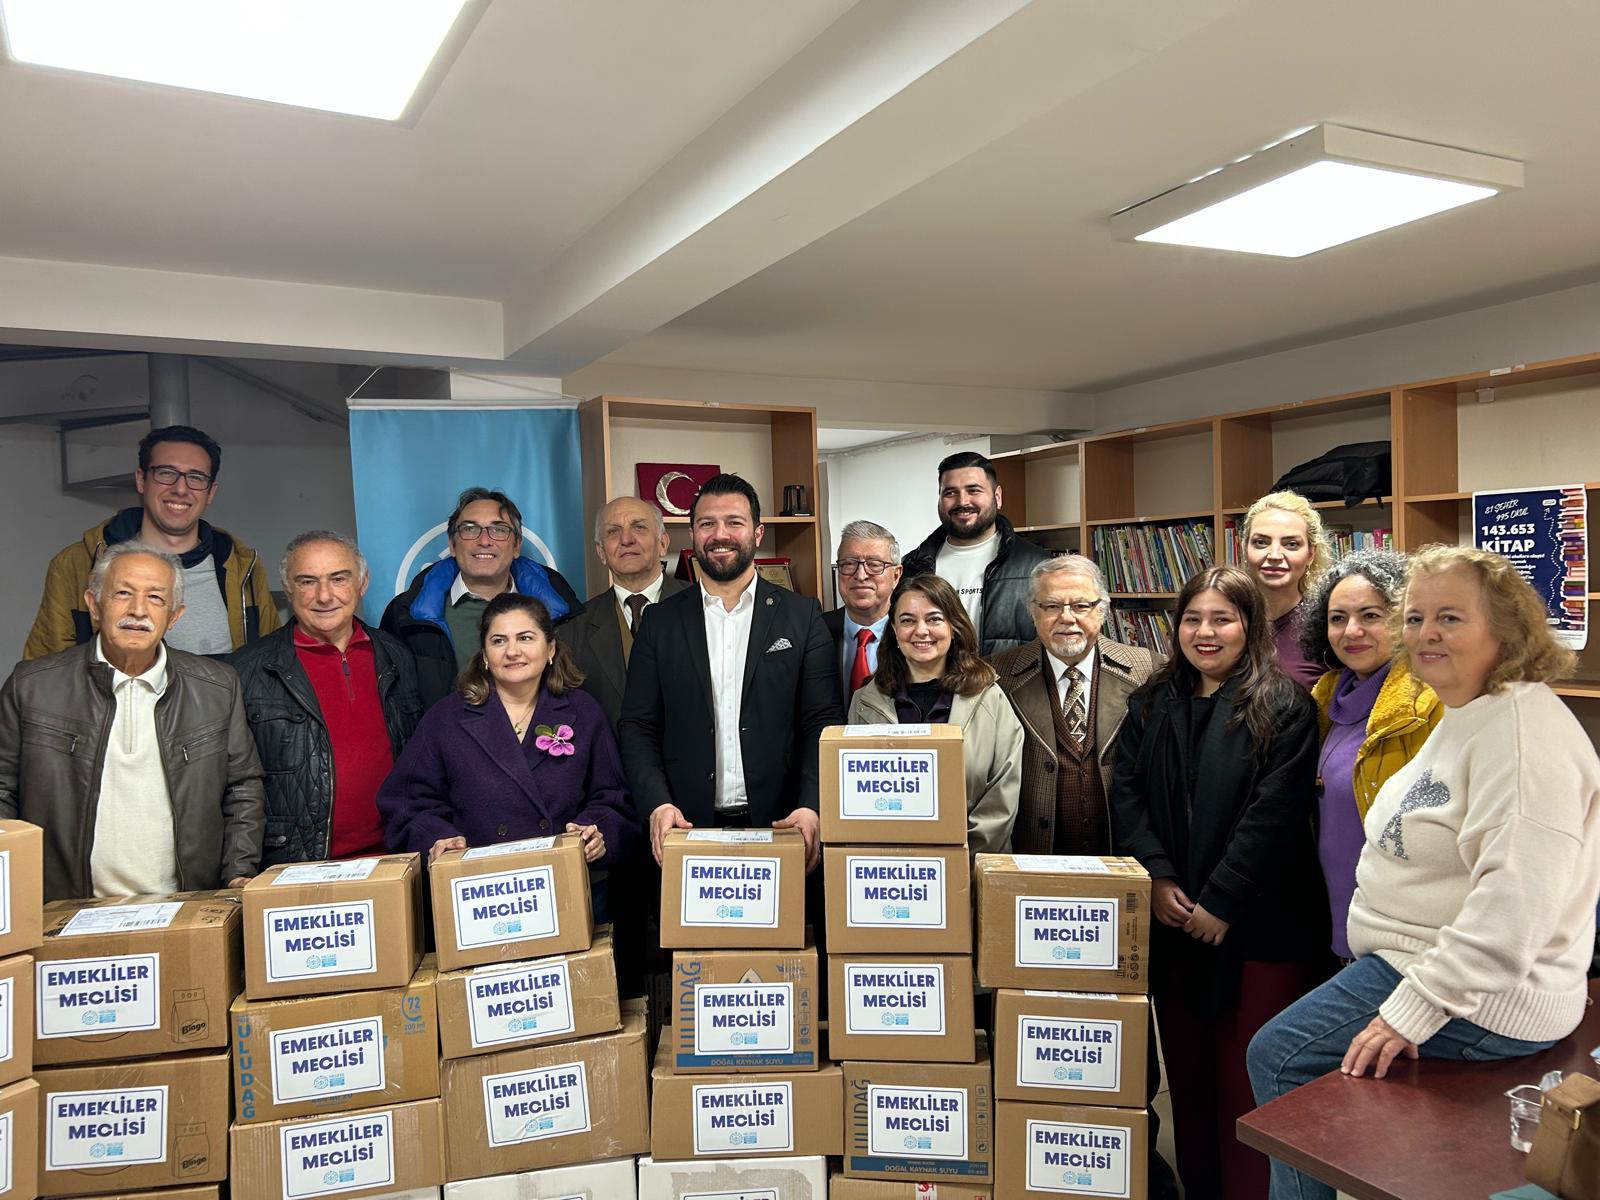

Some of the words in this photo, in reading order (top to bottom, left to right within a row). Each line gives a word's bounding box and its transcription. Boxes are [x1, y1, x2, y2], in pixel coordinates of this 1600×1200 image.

[1510, 507, 1529, 519] OKUL
[1481, 523, 1535, 536] 143.653
[1481, 537, 1535, 553] KİTAP
[848, 757, 928, 772] EMEKLİLER
[857, 777, 919, 793] MECLİSİ
[692, 864, 771, 880] EMEKLİLER
[856, 864, 936, 880] EMEKLİLER
[462, 877, 545, 901] EMEKLİLER
[700, 884, 761, 900] MECLİSİ
[865, 884, 927, 900] MECLİSİ
[473, 897, 537, 920] MECLİSİ
[1025, 905, 1109, 922] EMEKLİLER
[274, 911, 364, 933] EMEKLİLER
[1035, 926, 1099, 942] MECLİSİ
[286, 934, 355, 952] MECLİSİ
[48, 964, 148, 986] EMEKLİLER
[854, 971, 935, 987] EMEKLİLER
[476, 974, 560, 998] EMEKLİLER
[59, 986, 137, 1007] MECLİSİ
[408, 997, 420, 1009] 72
[704, 991, 784, 1007] EMEKLİLER
[864, 992, 926, 1007] MECLİSİ
[488, 994, 553, 1017] MECLİSİ
[713, 1010, 775, 1027] MECLİSİ
[182, 1022, 207, 1035] Bingo
[1028, 1025, 1112, 1043] EMEKLİLER
[281, 1028, 373, 1054] EMEKLİLER
[293, 1050, 363, 1074] MECLİSİ
[711, 1057, 735, 1066] DOĞAL
[736, 1058, 763, 1066] KAYNAK
[1036, 1046, 1101, 1064] MECLİSİ
[493, 1074, 577, 1098] EMEKLİLER
[58, 1096, 156, 1117] EMEKLİLER
[505, 1094, 569, 1117] MECLİSİ
[702, 1090, 783, 1108] EMEKLİLER
[877, 1094, 958, 1111] EMEKLİLER
[712, 1109, 774, 1128] MECLİSİ
[886, 1115, 949, 1132] MECLİSİ
[69, 1117, 145, 1139] MECLİSİ
[291, 1124, 382, 1149] EMEKLİLER
[1036, 1131, 1121, 1149] EMEKLİLER
[182, 1156, 207, 1171] Bingo
[303, 1145, 373, 1169] MECLİSİ
[1045, 1152, 1110, 1169] MECLİSİ
[884, 1164, 908, 1174] DOĞAL
[909, 1165, 938, 1174] KAYNAK
[939, 1167, 958, 1175] SUYU
